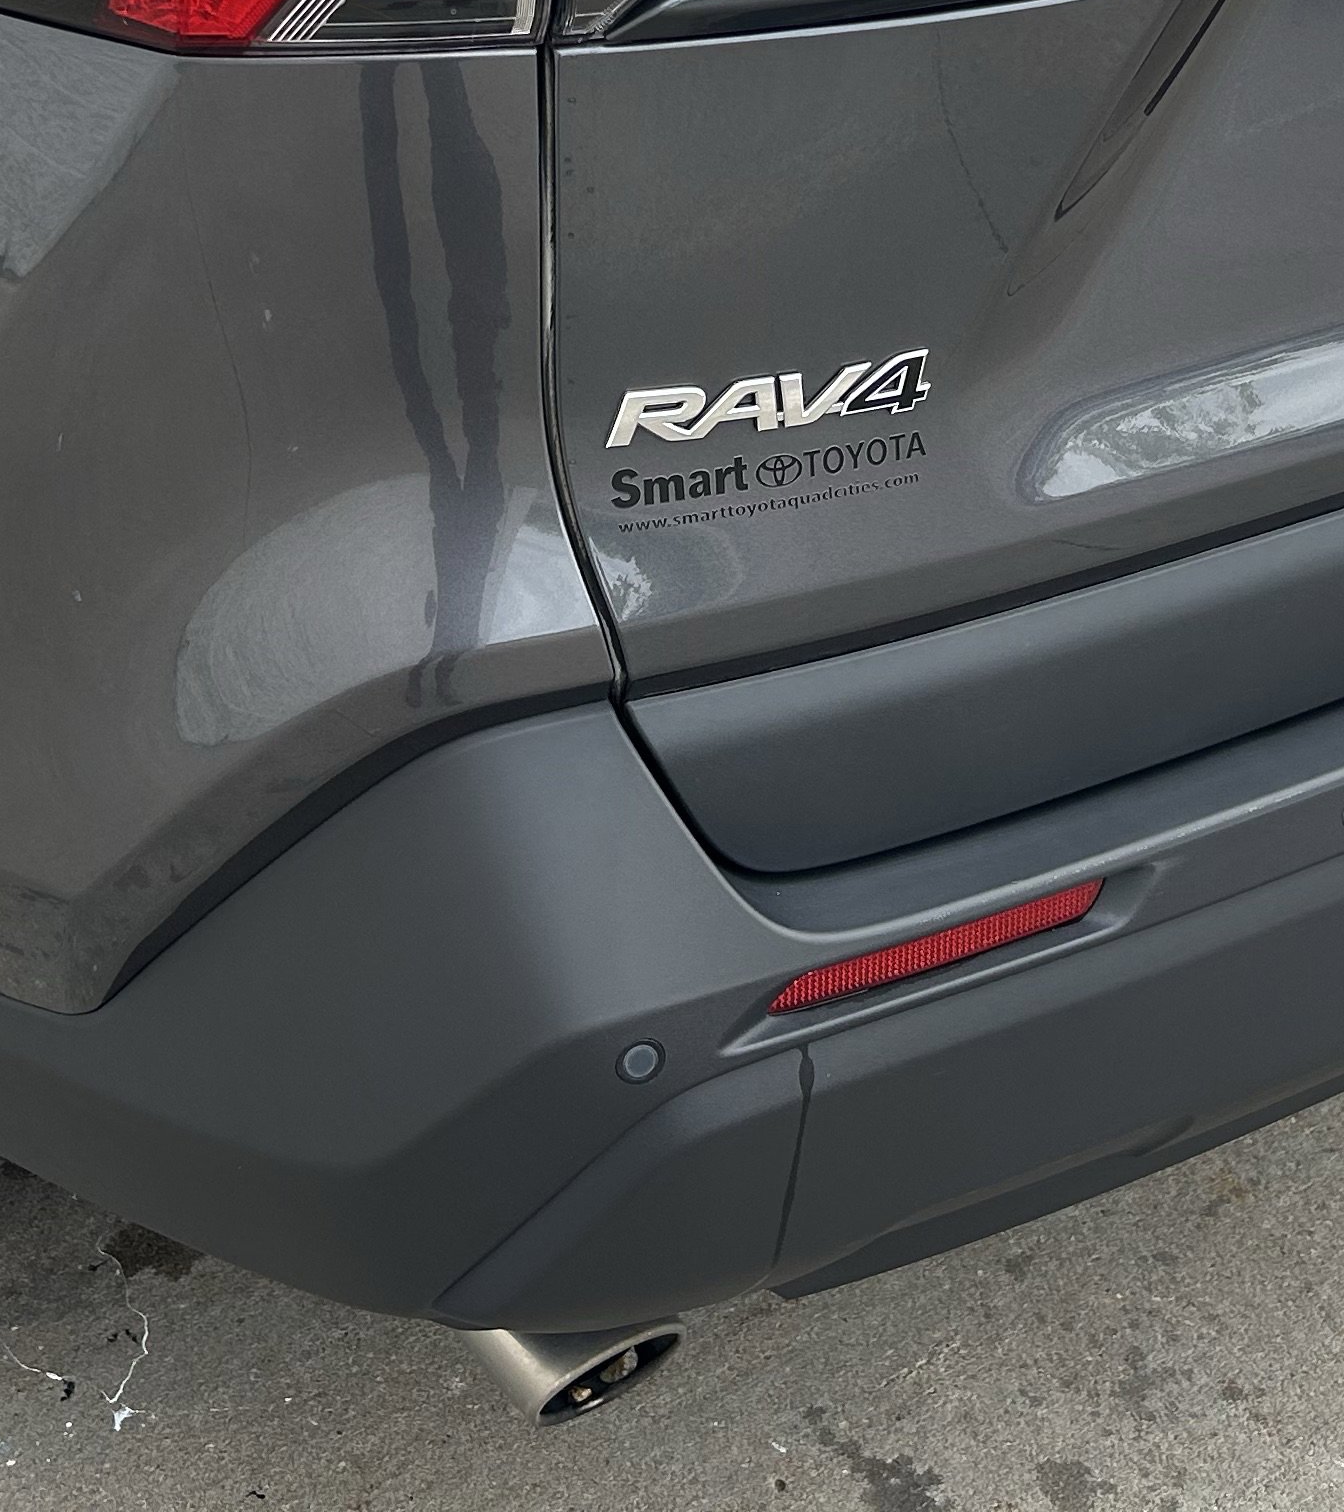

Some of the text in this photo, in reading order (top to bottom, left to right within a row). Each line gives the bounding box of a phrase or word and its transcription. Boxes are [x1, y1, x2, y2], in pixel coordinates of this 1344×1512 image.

[606, 347, 932, 449] RAV4
[610, 431, 927, 509] Smart TOYOTA
[617, 471, 920, 534] www.smarttoyotaquadcities.com
